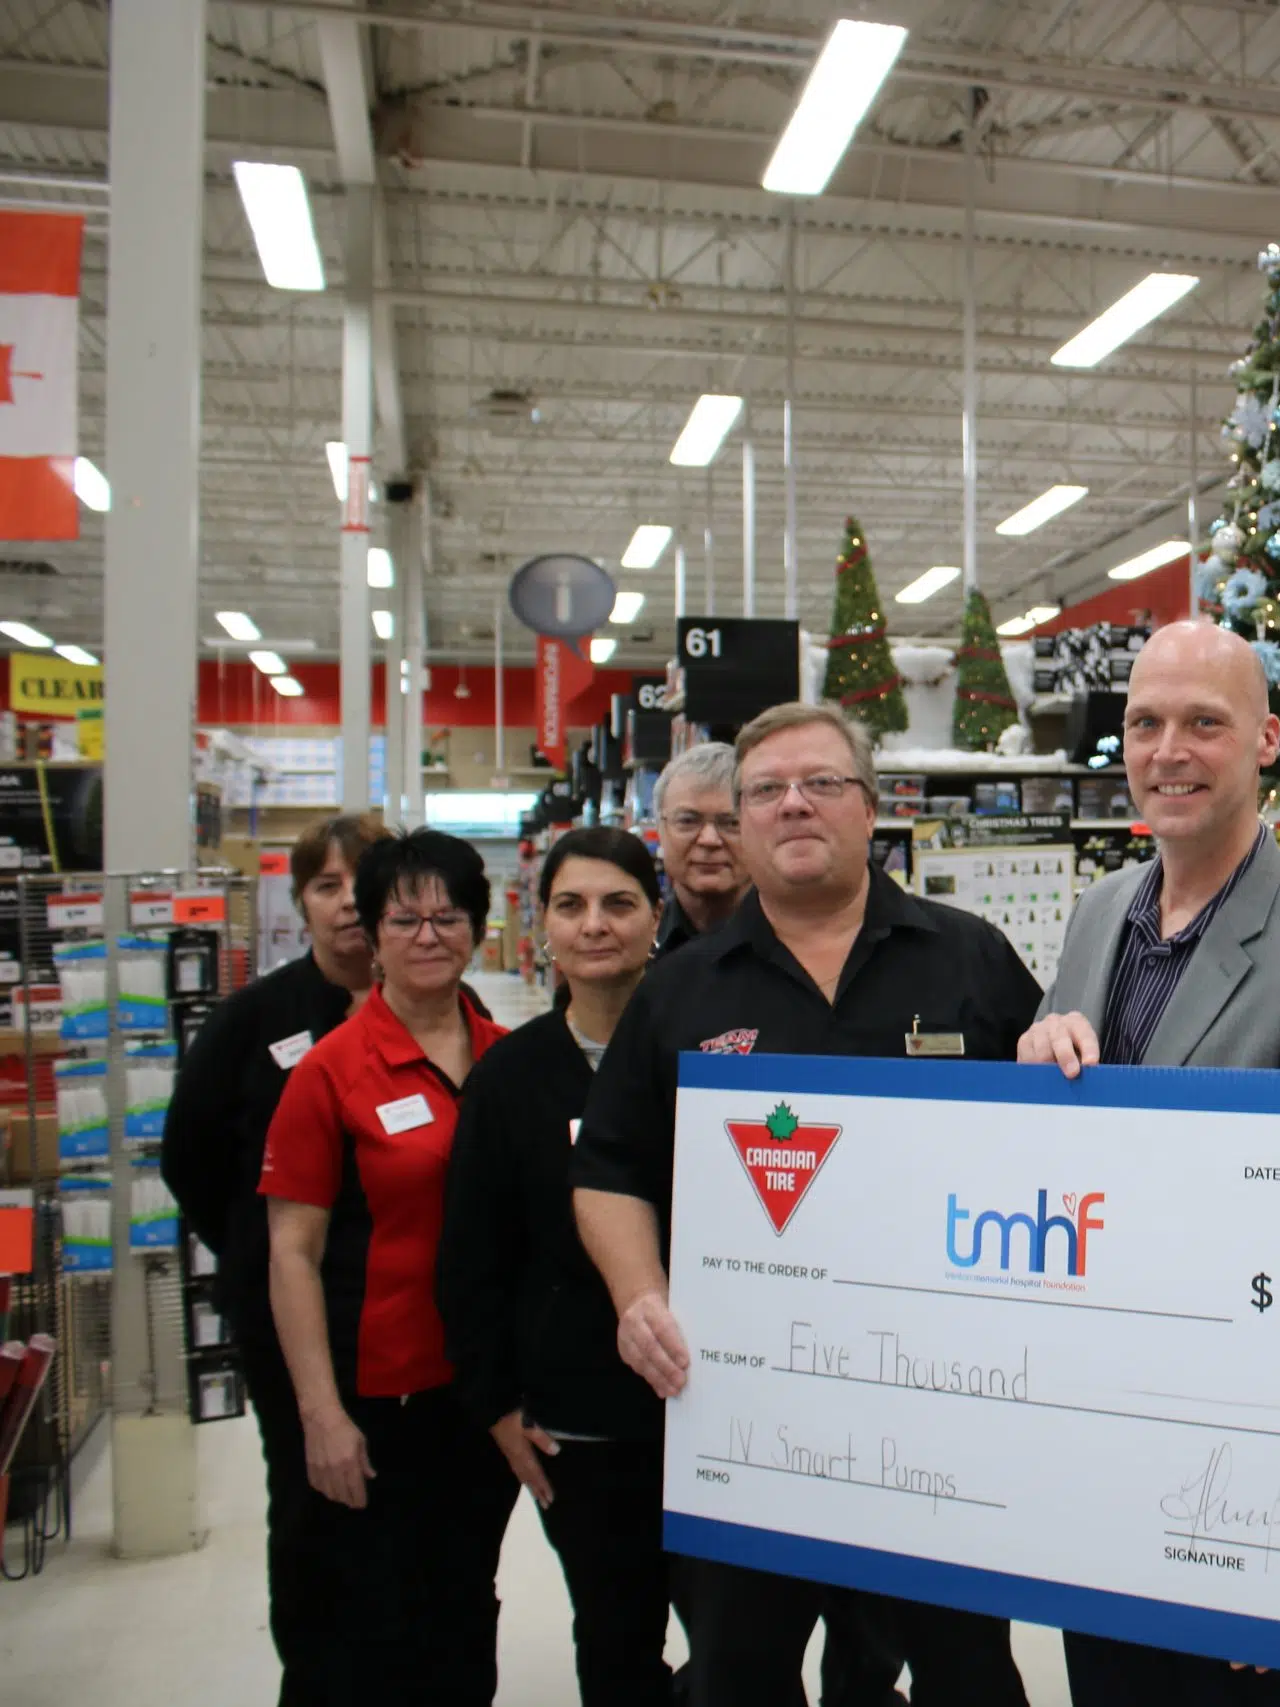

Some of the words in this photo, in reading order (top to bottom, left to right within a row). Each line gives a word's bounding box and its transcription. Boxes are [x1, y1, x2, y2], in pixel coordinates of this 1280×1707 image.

[685, 627, 722, 658] 61
[968, 816, 1029, 829] CHRISTMAS
[1030, 816, 1064, 828] TREES
[745, 1147, 816, 1170] CANADIAN
[765, 1171, 796, 1192] TIRE
[945, 1188, 1106, 1277] tmhf
[702, 1256, 722, 1271] PAY
[725, 1259, 742, 1272] TO
[745, 1260, 765, 1274] THE
[768, 1263, 807, 1278] ORDER
[811, 1267, 828, 1280] OF
[1010, 1277, 1042, 1289] hospital
[1250, 1272, 1274, 1313] $
[700, 1349, 720, 1363] THE
[723, 1352, 747, 1366] SUM
[750, 1356, 766, 1368] OF
[787, 1320, 850, 1378] Five
[866, 1330, 1029, 1401] Thousand
[696, 1469, 730, 1485] MEMO
[770, 1423, 857, 1481] Smart
[880, 1436, 957, 1515] Pumps
[1164, 1546, 1246, 1572] SIGNATURE
